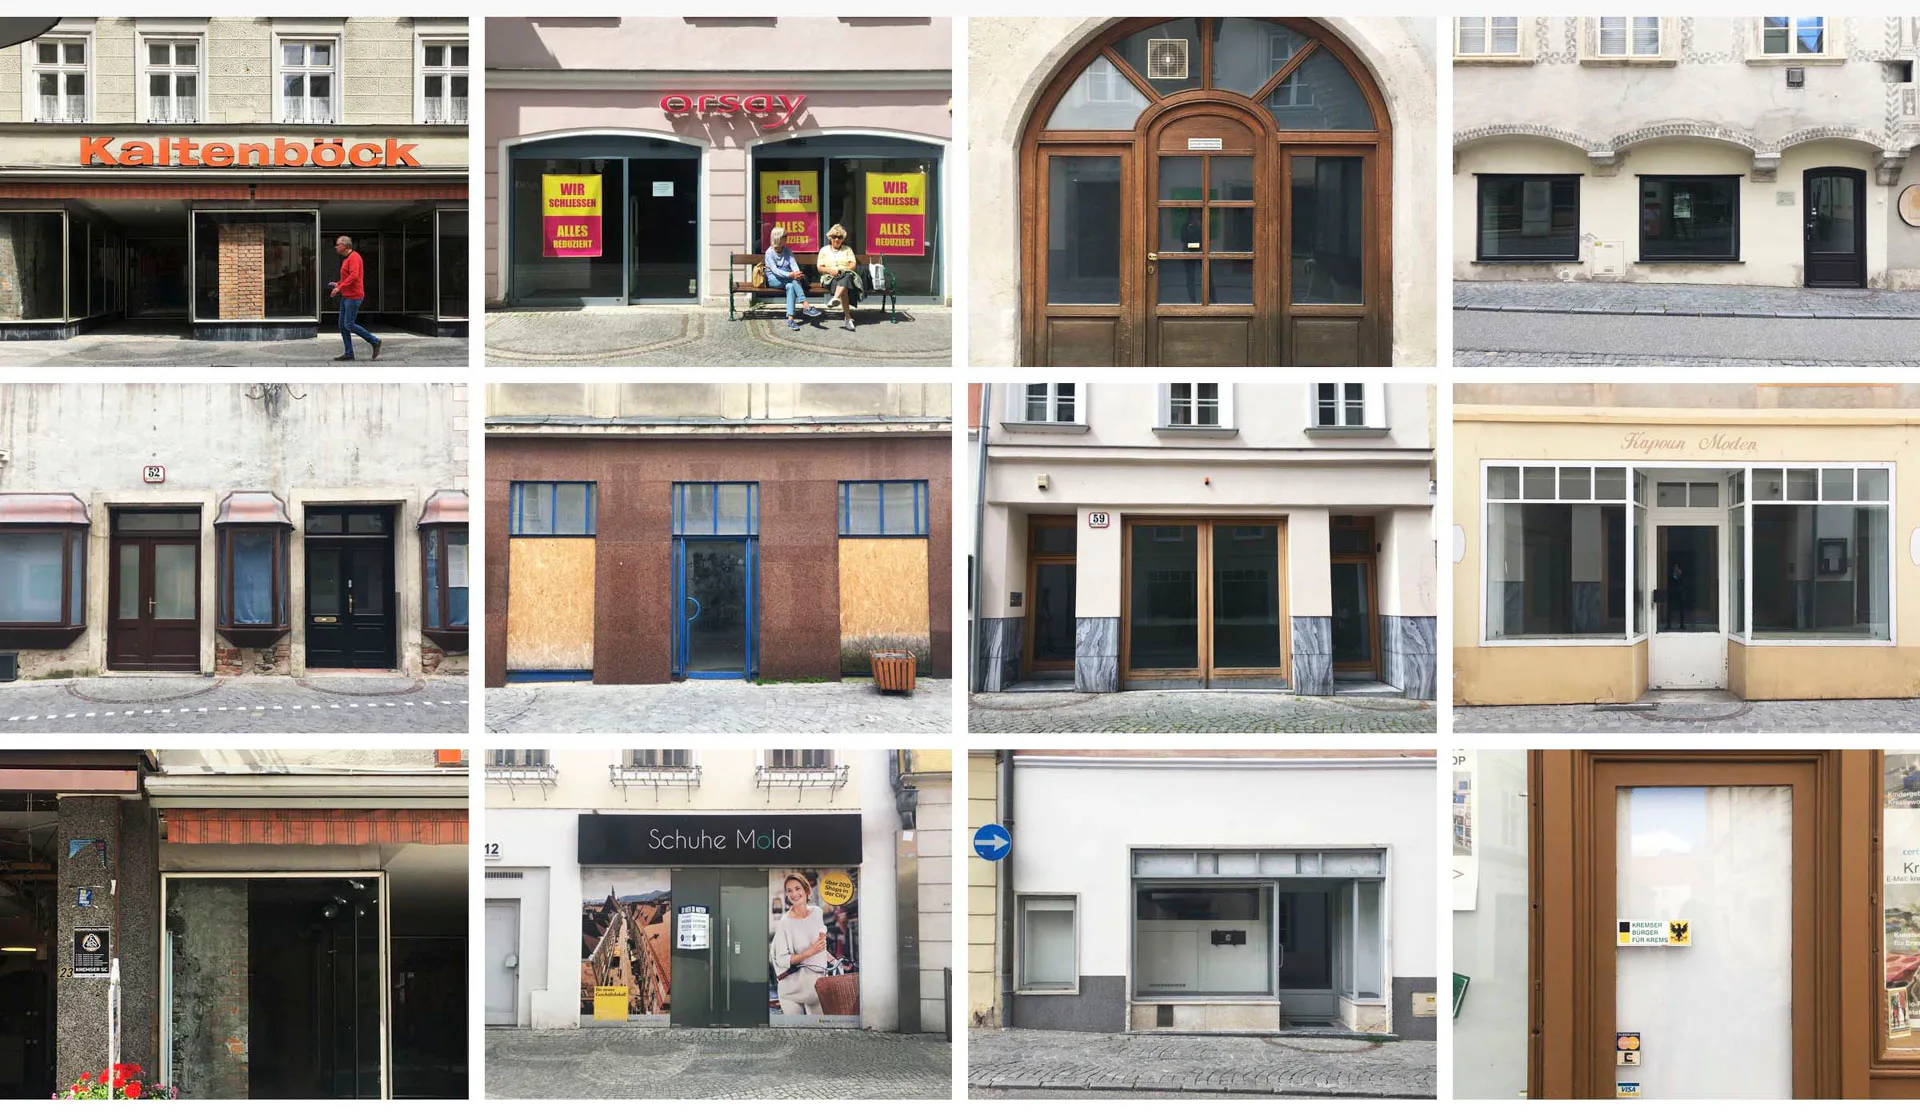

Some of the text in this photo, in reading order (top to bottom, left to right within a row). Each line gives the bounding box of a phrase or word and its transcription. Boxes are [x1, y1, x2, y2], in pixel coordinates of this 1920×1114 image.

[659, 93, 806, 129] orsay
[80, 136, 422, 167] Kaltenböck
[560, 182, 585, 196] WIR
[883, 181, 908, 194] WIR
[549, 198, 597, 208] SCHLIESSEN
[871, 196, 919, 206] SCHLIESSEN
[556, 225, 589, 238] ALLES
[880, 223, 911, 236] ALLES
[553, 240, 593, 249] REDUZIERT
[875, 238, 916, 247] REDUZIERT
[1621, 431, 1757, 454] Kapoun Moden
[148, 467, 161, 478] 52
[1093, 513, 1105, 523] 59
[648, 828, 792, 850] Schuhe Mold
[484, 843, 499, 854] 12
[60, 968, 74, 978] 23
